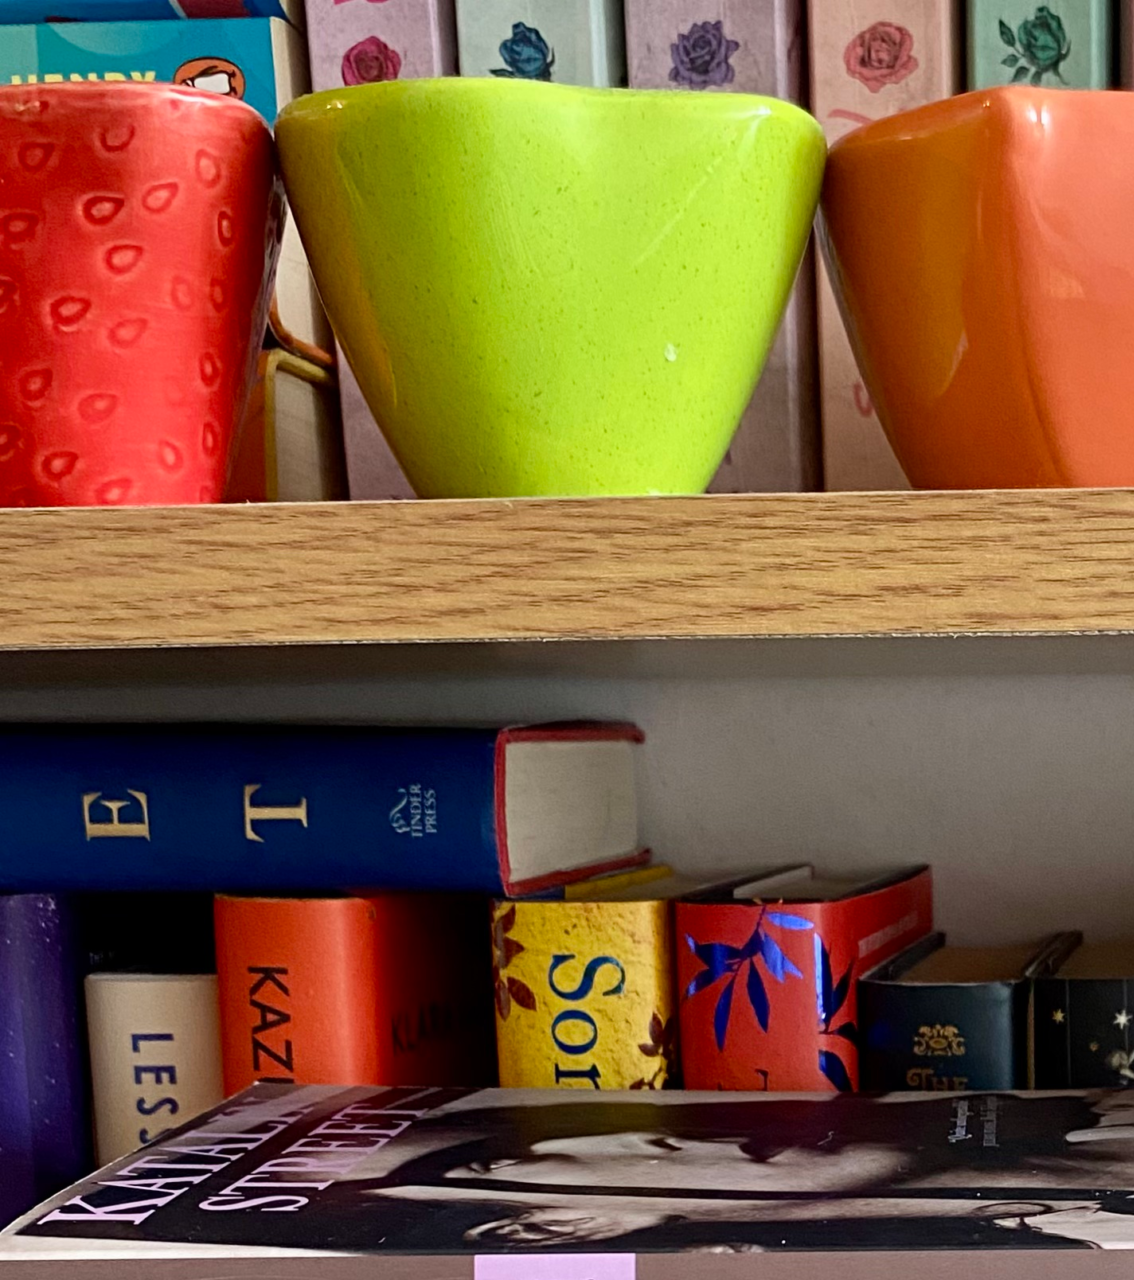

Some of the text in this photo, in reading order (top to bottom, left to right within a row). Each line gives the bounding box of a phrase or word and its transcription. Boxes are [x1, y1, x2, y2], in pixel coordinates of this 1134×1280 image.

[409, 783, 423, 838] TINDER
[424, 788, 437, 834] PRESS
[199, 1103, 430, 1212] STREET
